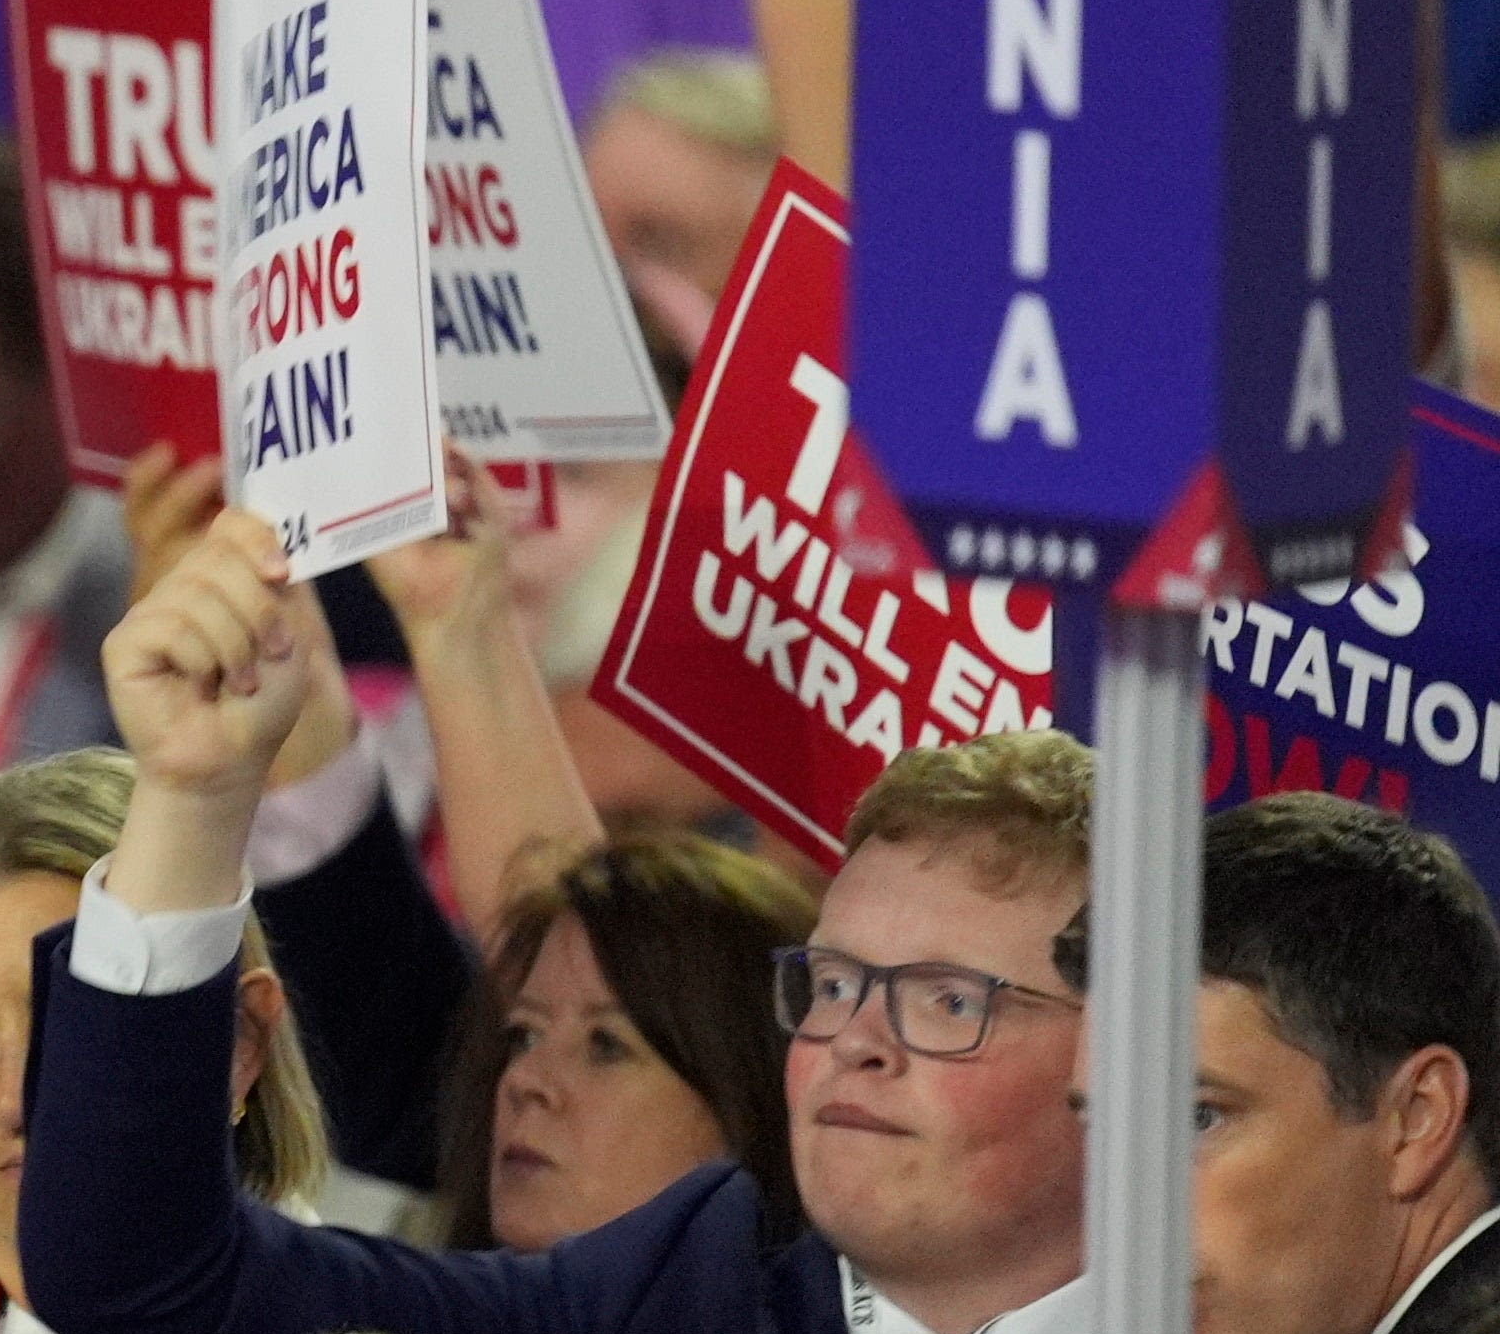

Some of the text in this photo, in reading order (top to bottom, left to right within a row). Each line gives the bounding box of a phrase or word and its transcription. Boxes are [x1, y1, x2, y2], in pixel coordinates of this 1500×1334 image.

[46, 25, 215, 186] TRU
[44, 182, 170, 277] WILL
[230, 106, 365, 241] ERICA
[56, 273, 215, 369] UKRAI
[231, 225, 360, 360] RONG
[434, 268, 538, 354] AIN!
[239, 349, 352, 479] GAIN!
[283, 515, 310, 551] 24
[694, 548, 925, 768] UKRA
[723, 469, 918, 682] WILL
[923, 639, 1052, 747] EN
[1200, 597, 1500, 785] RTATIO
